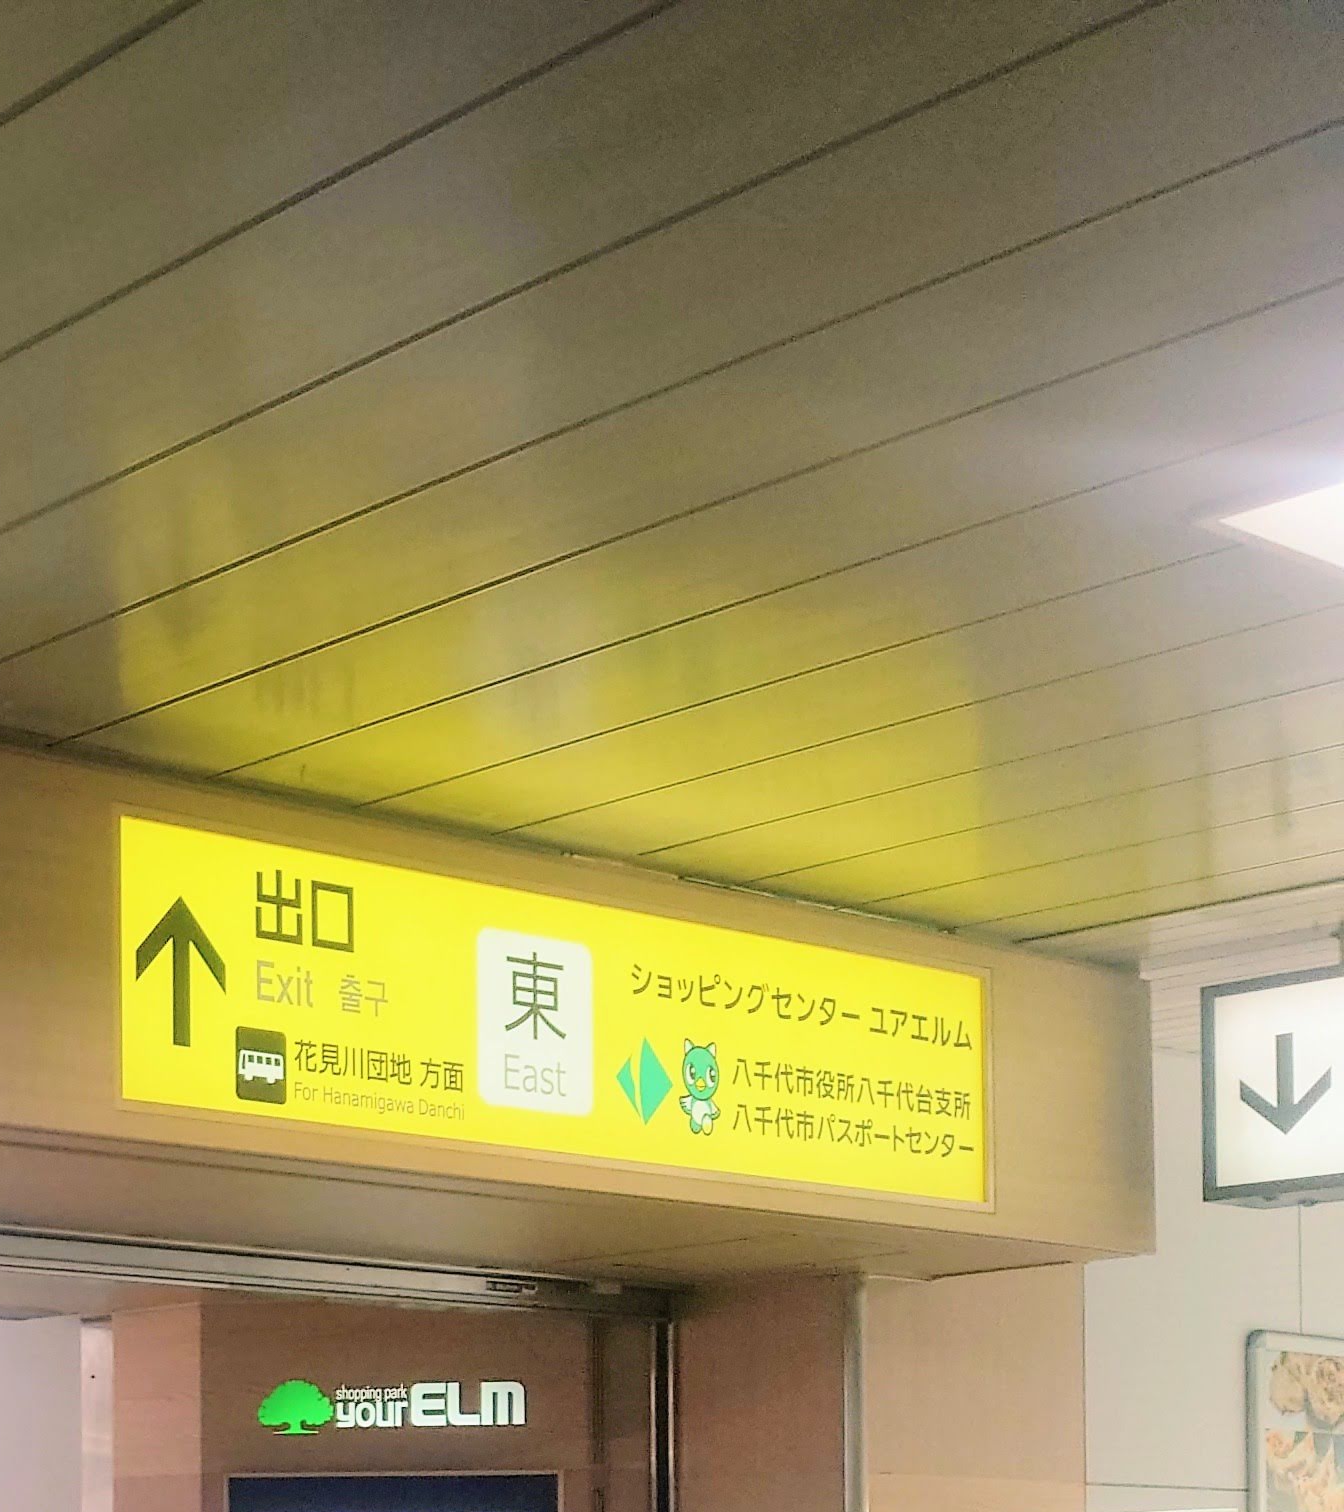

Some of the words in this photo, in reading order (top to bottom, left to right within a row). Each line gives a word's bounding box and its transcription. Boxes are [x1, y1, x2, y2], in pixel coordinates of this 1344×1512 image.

[256, 869, 354, 952] 出口
[256, 960, 313, 1008] Exit
[338, 973, 389, 1018] 출구
[505, 952, 567, 1040] 東
[503, 1053, 567, 1098] East
[732, 1057, 970, 1121] 八千代市役所八千代台支所
[294, 1081, 319, 1101] For
[323, 1085, 414, 1114] Hanamigawa
[418, 1098, 465, 1120] Danchi
[733, 1103, 975, 1158] 八千代市パスポートセンター
[335, 1383, 382, 1402] shopping
[384, 1383, 407, 1401] park
